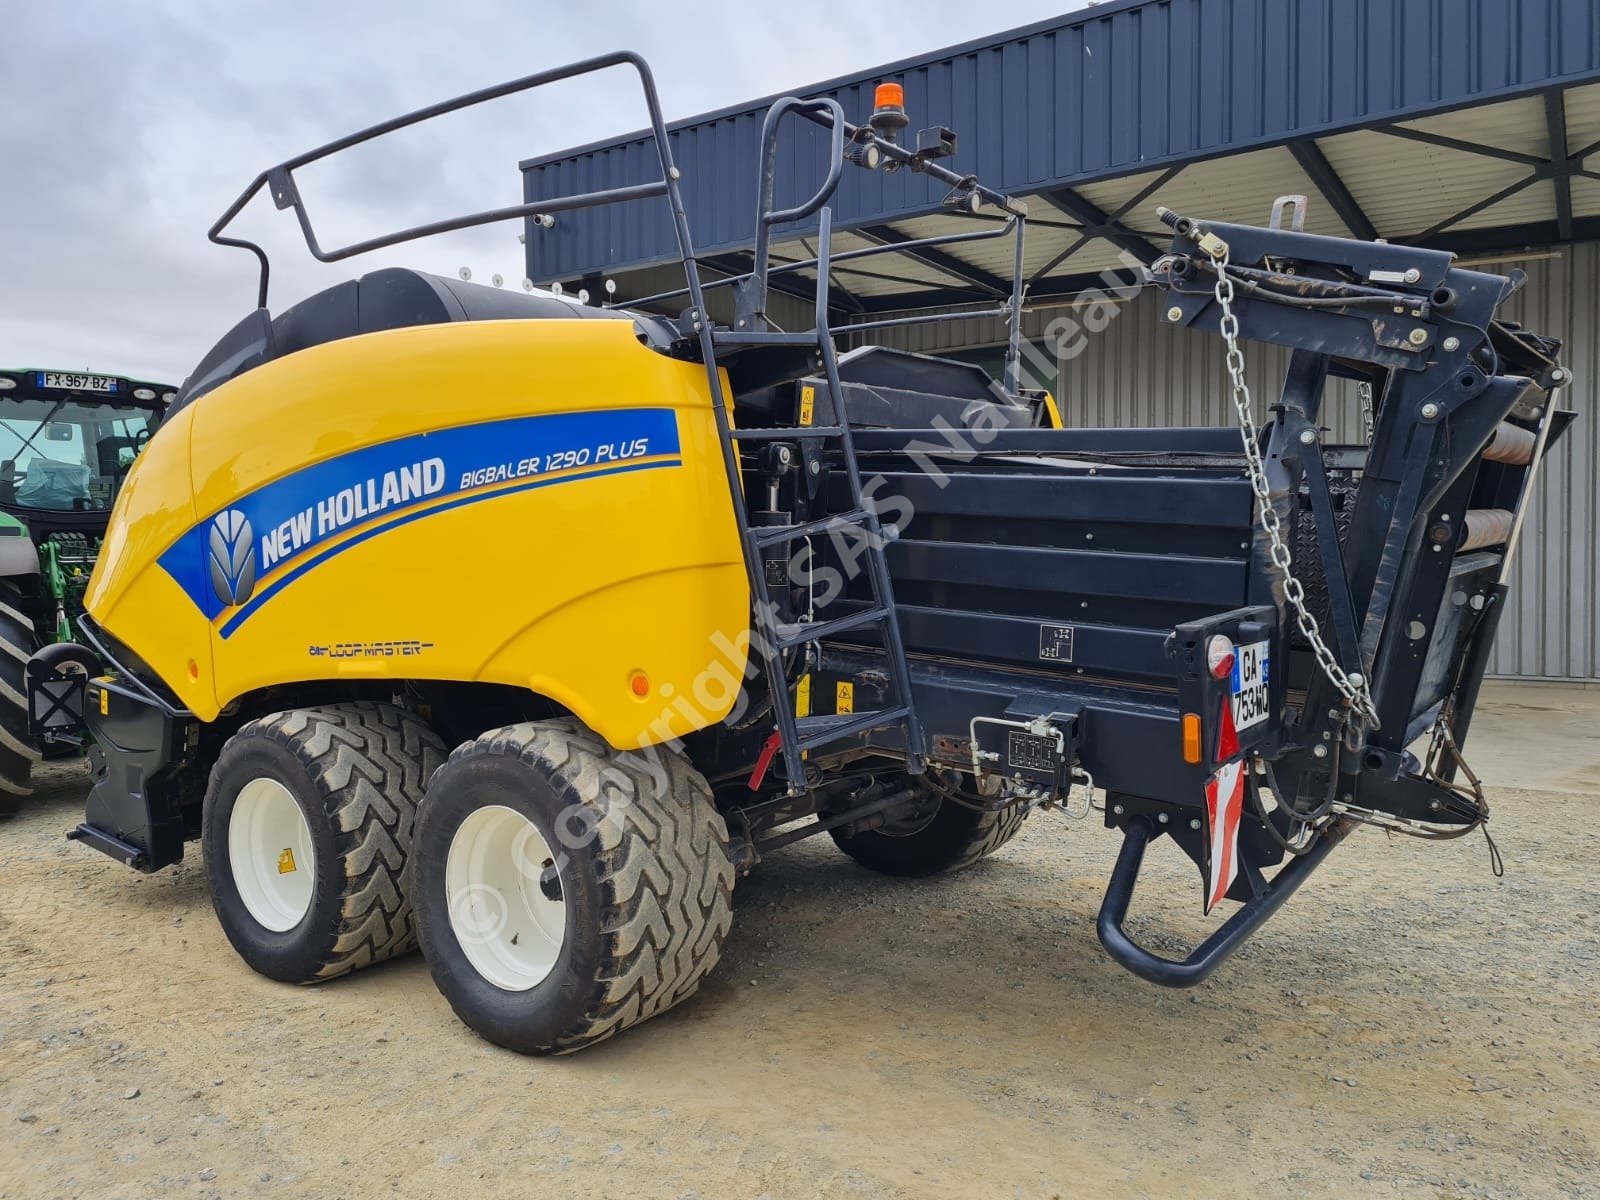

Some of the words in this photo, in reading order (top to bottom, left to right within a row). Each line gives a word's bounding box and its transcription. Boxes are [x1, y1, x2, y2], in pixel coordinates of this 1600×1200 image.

[460, 457, 540, 489] BIGBALER
[545, 448, 590, 471] 1290
[595, 438, 649, 463] PLUS
[261, 507, 313, 570] NEW
[317, 457, 446, 536] HOLLAND
